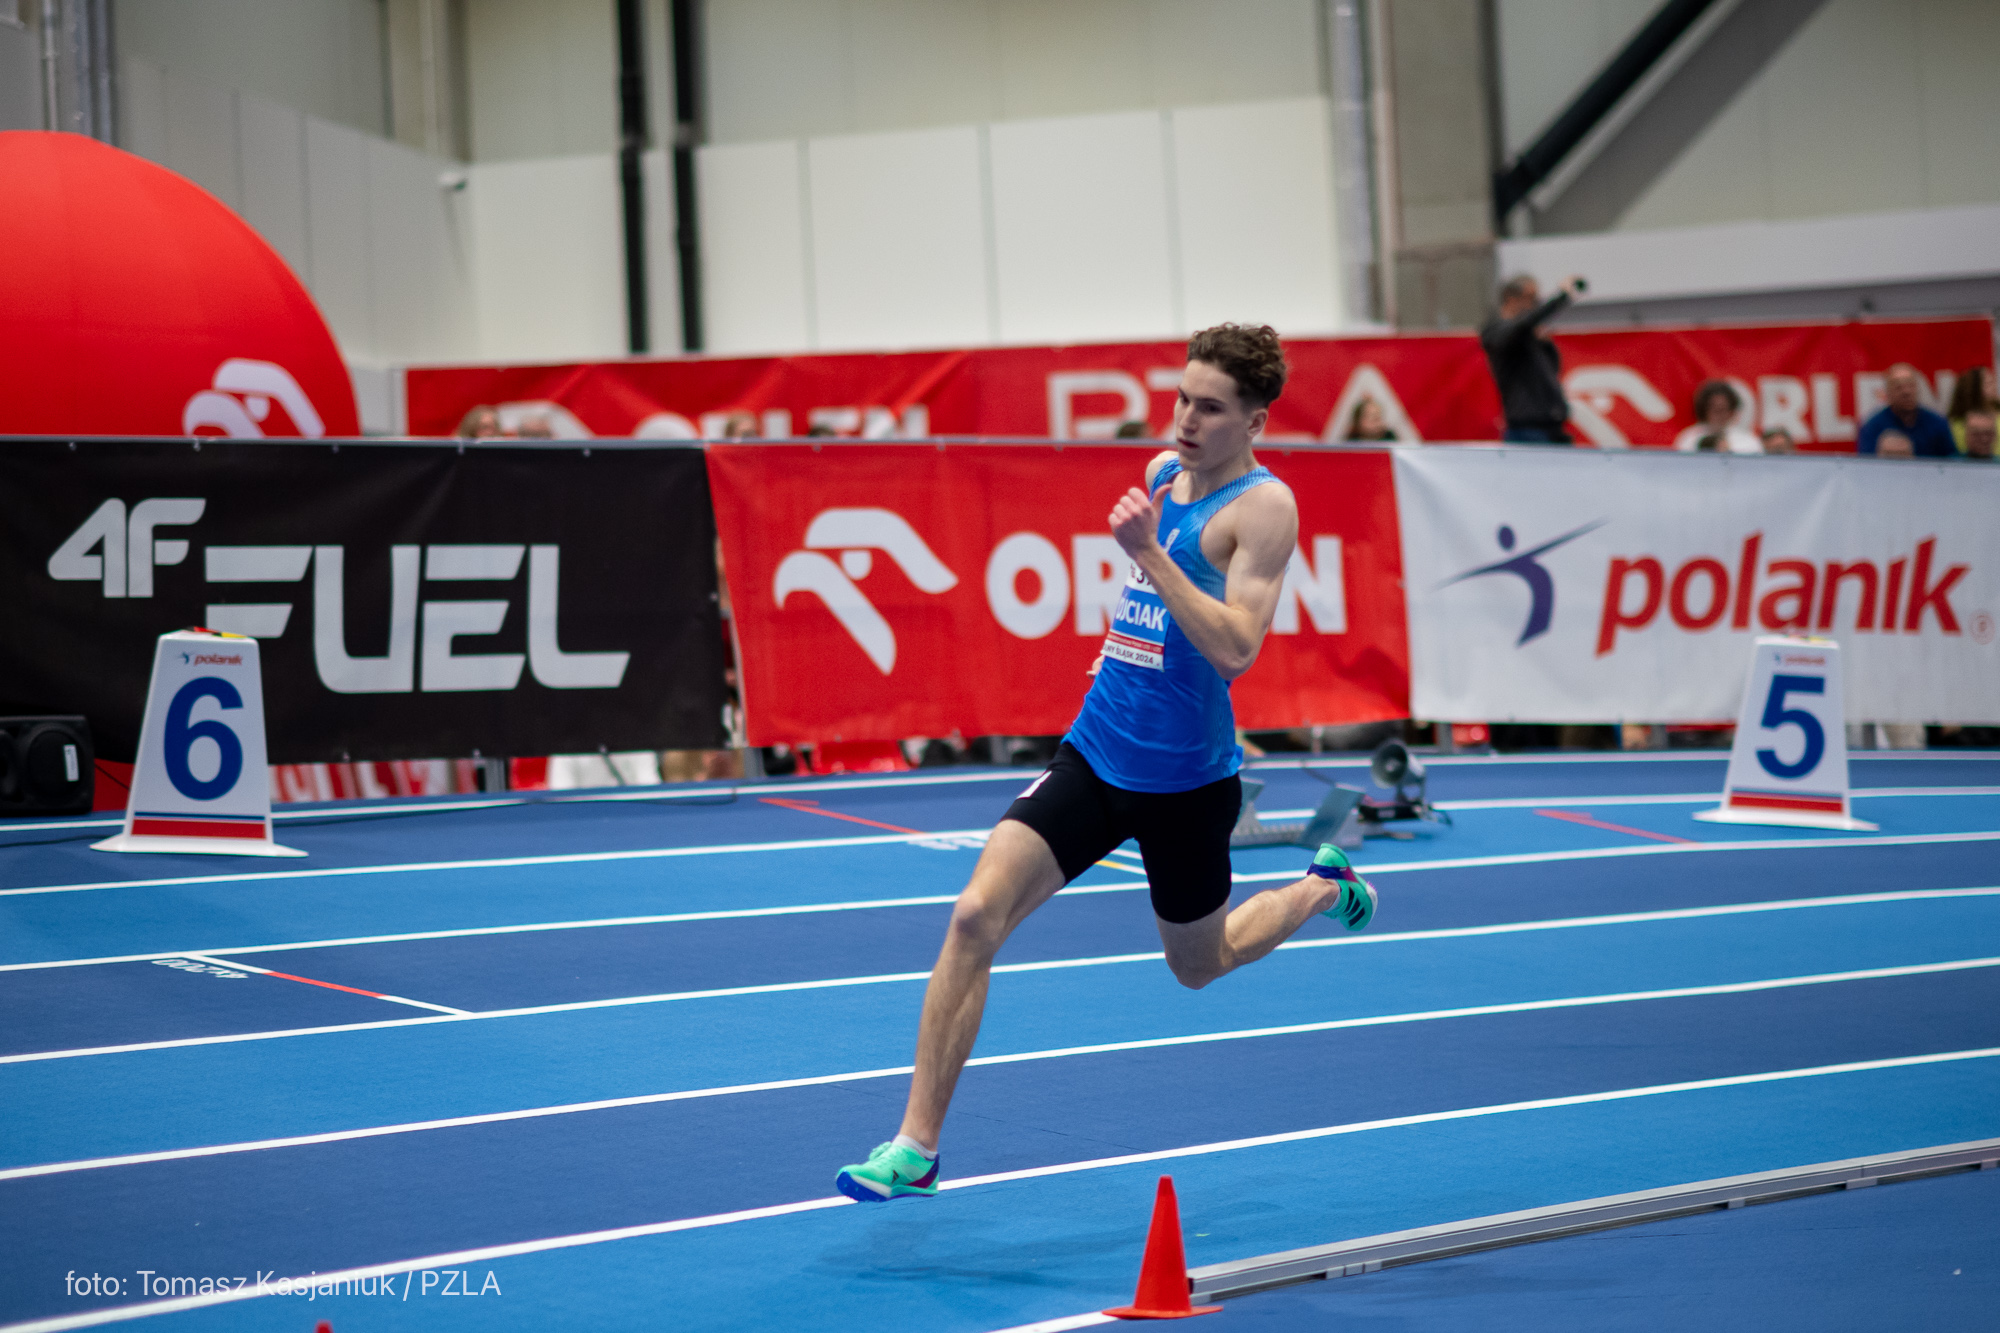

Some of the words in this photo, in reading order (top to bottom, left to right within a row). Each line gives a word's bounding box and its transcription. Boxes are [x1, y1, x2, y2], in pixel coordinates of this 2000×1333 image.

[1047, 364, 1425, 442] PA
[48, 498, 206, 597] 4F
[205, 544, 630, 692] FUEL
[985, 531, 1348, 639] ORN
[1594, 530, 1973, 659] polanik
[194, 653, 243, 667] polanik
[1135, 652, 1154, 665] 2024
[163, 676, 244, 801] 6
[1755, 673, 1827, 780] 5
